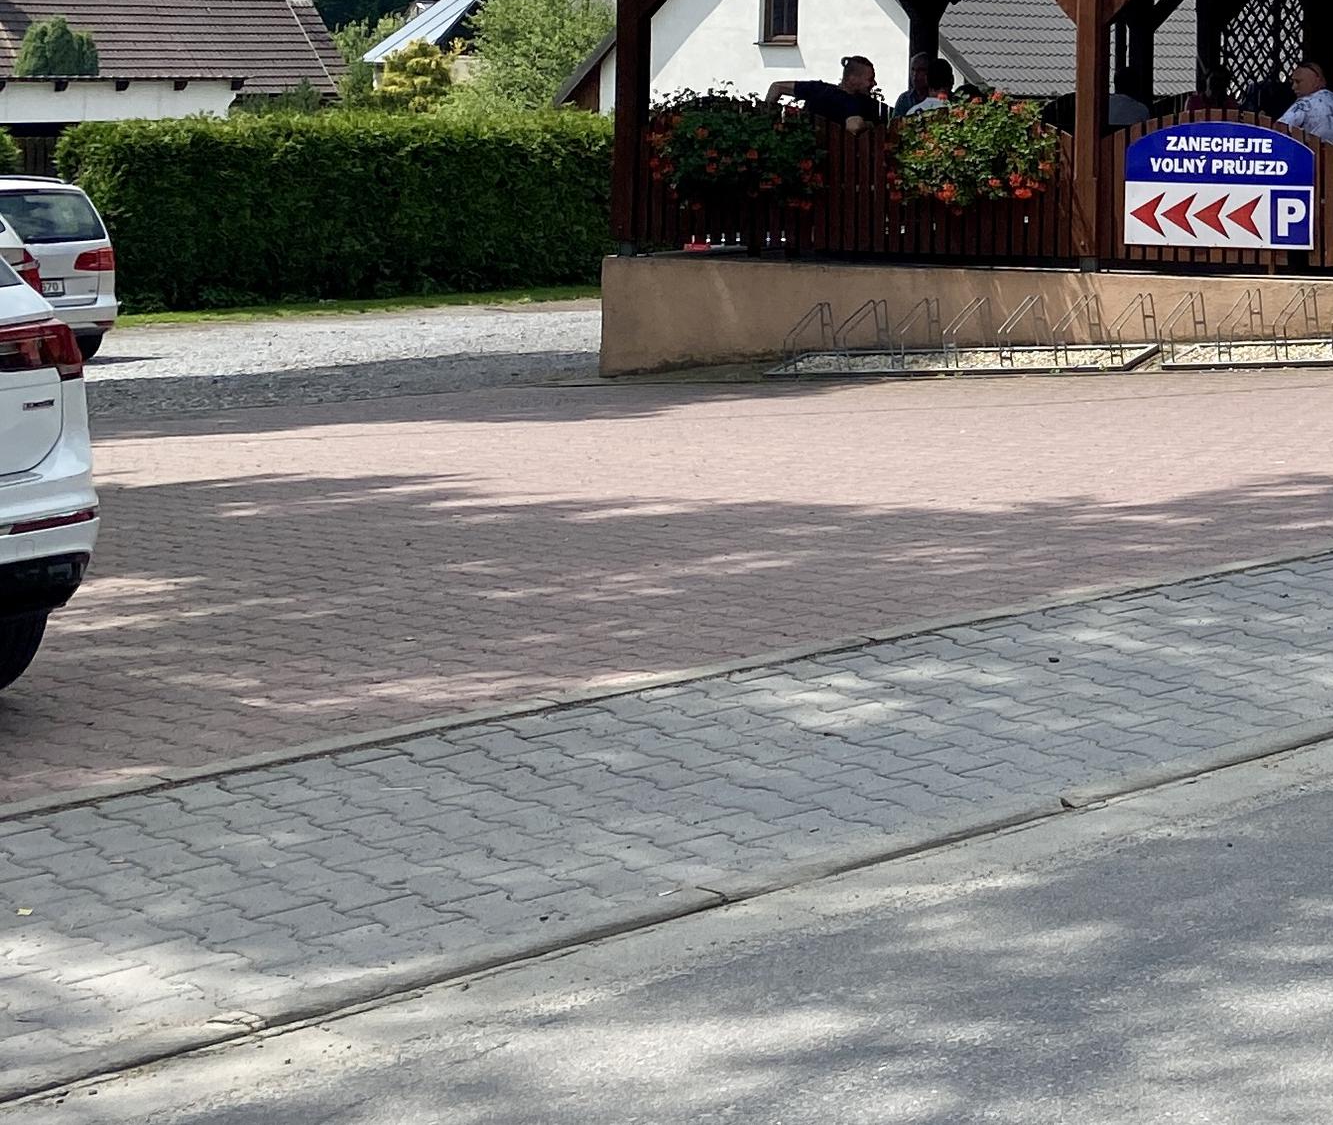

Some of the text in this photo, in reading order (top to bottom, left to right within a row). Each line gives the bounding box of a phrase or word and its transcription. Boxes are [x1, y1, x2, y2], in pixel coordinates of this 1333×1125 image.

[1165, 136, 1273, 154] ZANECHEJTE
[1150, 155, 1289, 176] VOLNÝ PRŮJEZD
[1277, 198, 1307, 237] P
